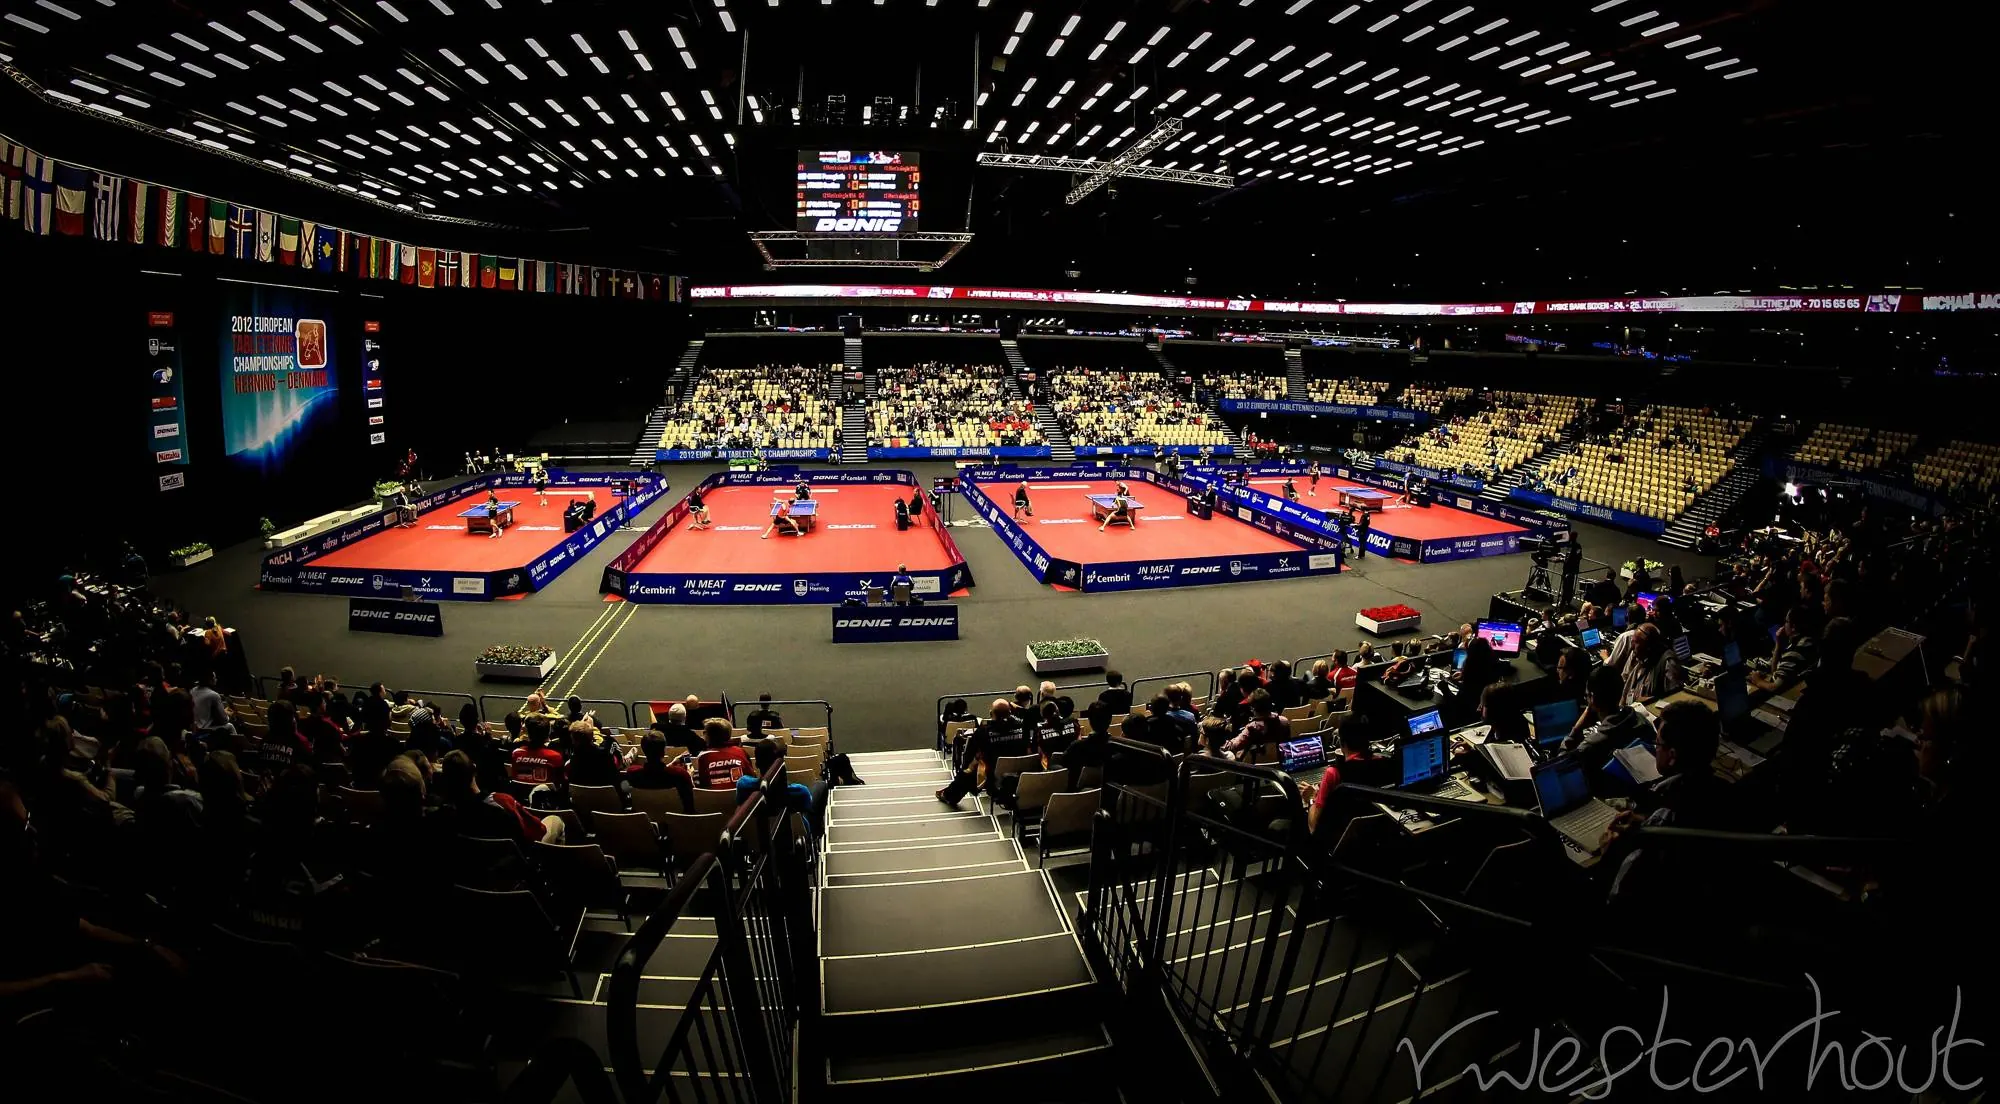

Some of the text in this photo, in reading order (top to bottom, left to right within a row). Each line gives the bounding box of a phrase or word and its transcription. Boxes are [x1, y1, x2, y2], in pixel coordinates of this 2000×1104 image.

[815, 218, 901, 231] DONIC
[1808, 299, 1820, 309] 70
[1821, 299, 1832, 309] 15
[1833, 299, 1846, 309] 65
[1846, 299, 1860, 309] 65
[1922, 293, 1976, 312] MICHAEL
[232, 316, 293, 333] 2012 EUROPEAN
[233, 355, 294, 373] CHAMPIONSHIPS
[235, 371, 328, 394] HERNING DENMARK
[1237, 401, 1250, 410] 2012
[1250, 402, 1279, 411] EUROPEAN
[1279, 403, 1315, 413] TABLETENNIS
[679, 450, 695, 460] 2012
[768, 449, 817, 460] CHAMPIONSHIPS
[930, 447, 991, 456] HERNING DENMARK
[872, 472, 892, 481] FUJITSU
[1105, 469, 1126, 478] FUJITSU
[1582, 504, 1613, 521] DENMARK
[1322, 518, 1341, 534] FUJITSU
[1519, 516, 1543, 526] DONIC
[1293, 531, 1315, 545] DONIC
[1366, 533, 1391, 549] MCH
[1461, 539, 1477, 548] MEAT
[1480, 540, 1504, 548] DONIC
[1150, 564, 1175, 574] MEAT
[1180, 565, 1221, 575] DONIC
[1268, 566, 1301, 574] GRUNDFOS
[269, 575, 293, 584] Cembrit
[308, 572, 328, 582] MEAT
[330, 577, 364, 585] DONIC
[1097, 574, 1131, 584] Cembrit
[698, 580, 727, 589] MEAT
[733, 583, 783, 591] DONIC
[640, 585, 676, 595] Cembrit
[689, 589, 701, 597] Only
[352, 609, 435, 623] DONIC DONIC
[836, 617, 955, 628] DONIC DONIC
[516, 756, 548, 765] DONIC
[708, 758, 742, 769] DONIC
